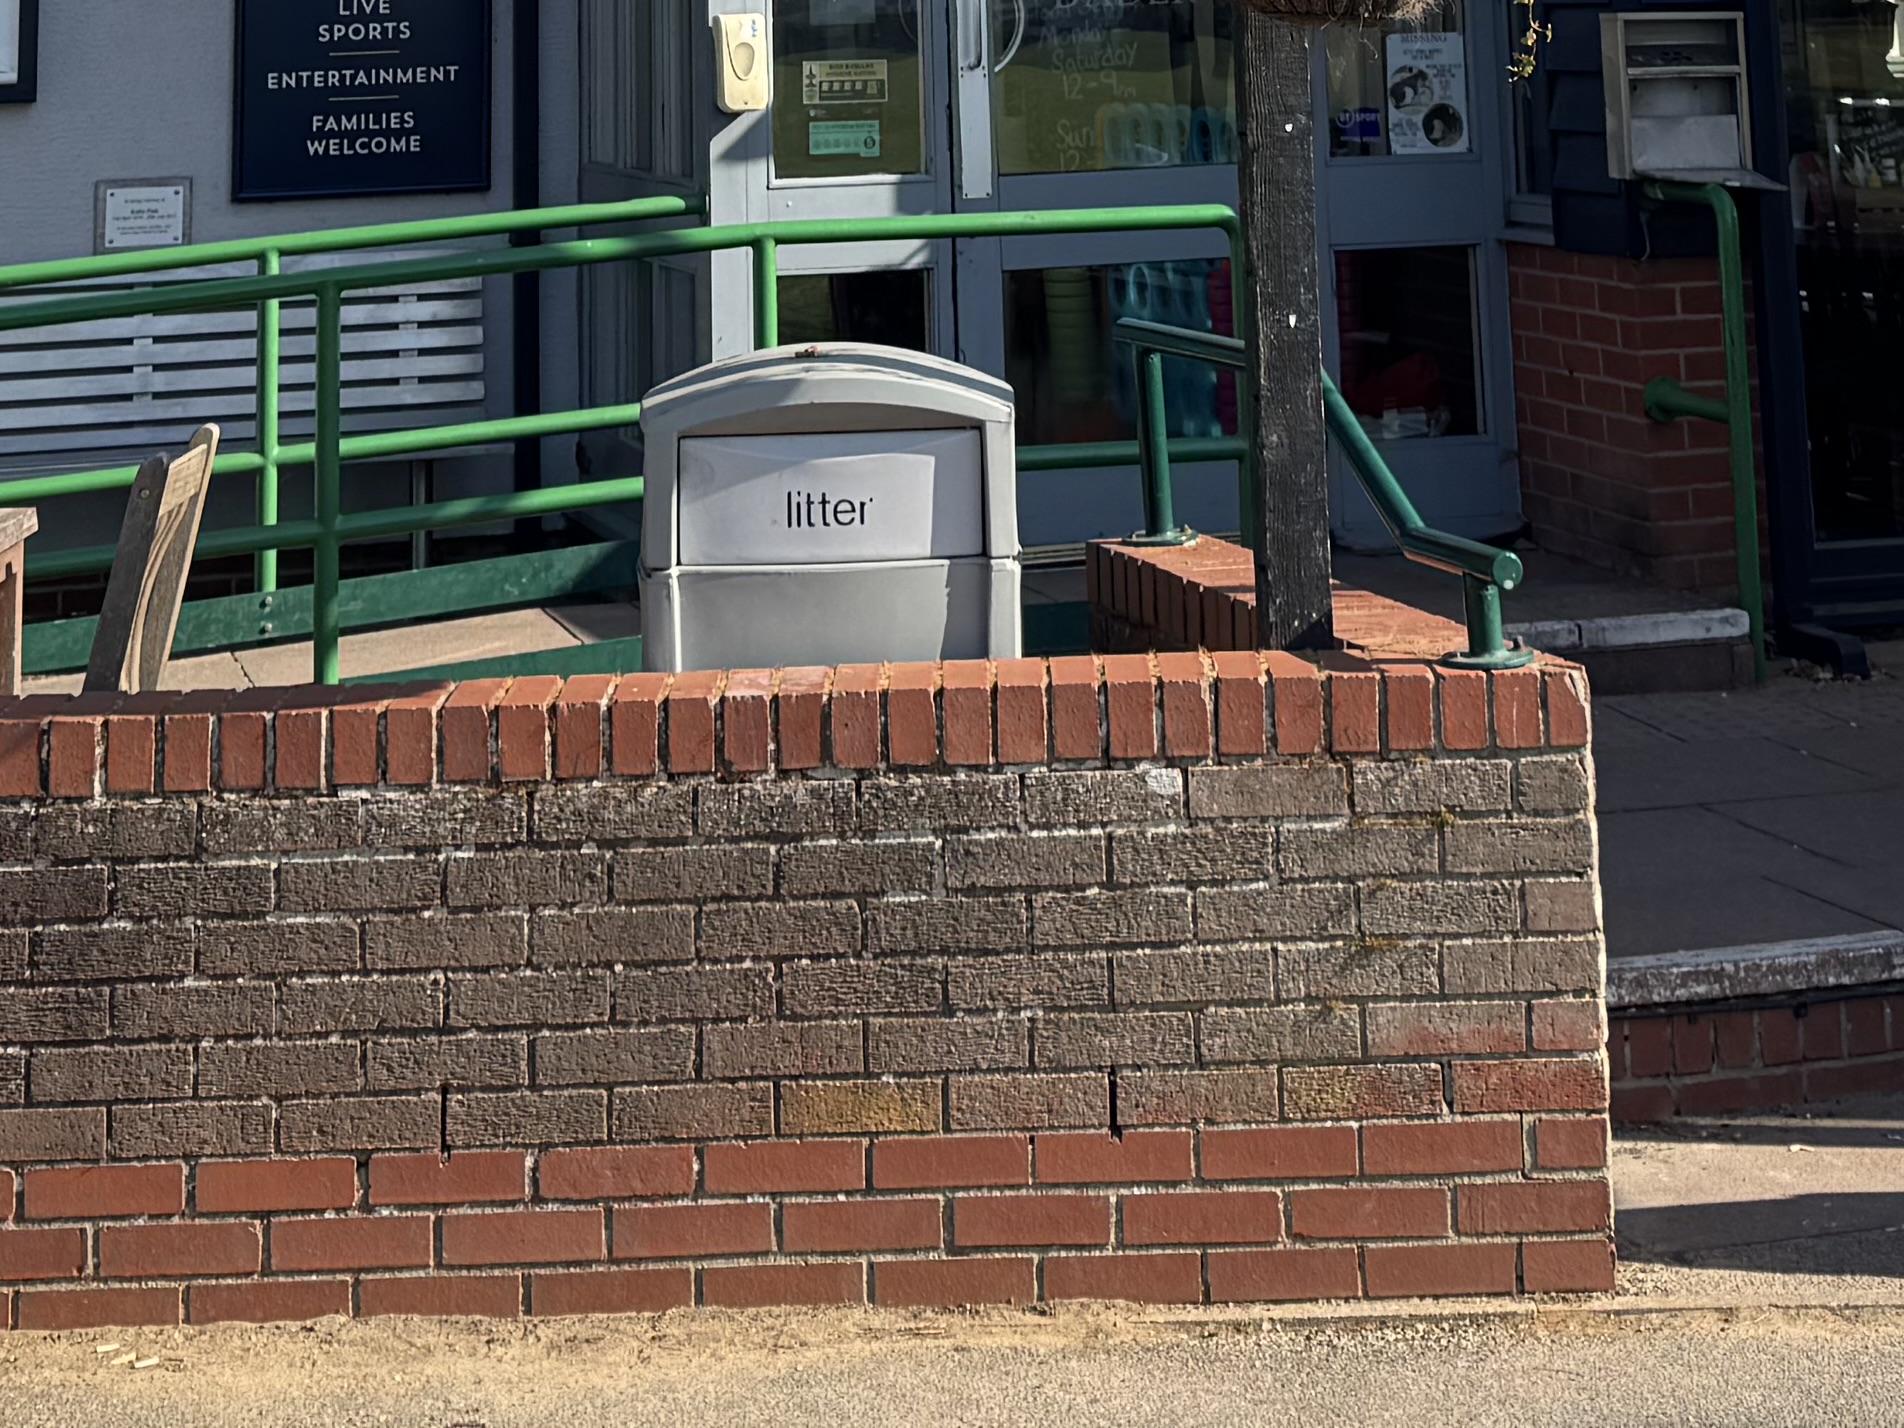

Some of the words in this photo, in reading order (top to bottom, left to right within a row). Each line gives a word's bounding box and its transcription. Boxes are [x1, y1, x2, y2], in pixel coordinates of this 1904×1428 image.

[318, 21, 411, 42] SPORTS
[1051, 41, 1138, 74] Saturday
[267, 65, 460, 90] ENTERTAINMENT
[312, 111, 415, 132] FAMILIES
[307, 135, 422, 156] WELCOME
[786, 490, 874, 529] litter
